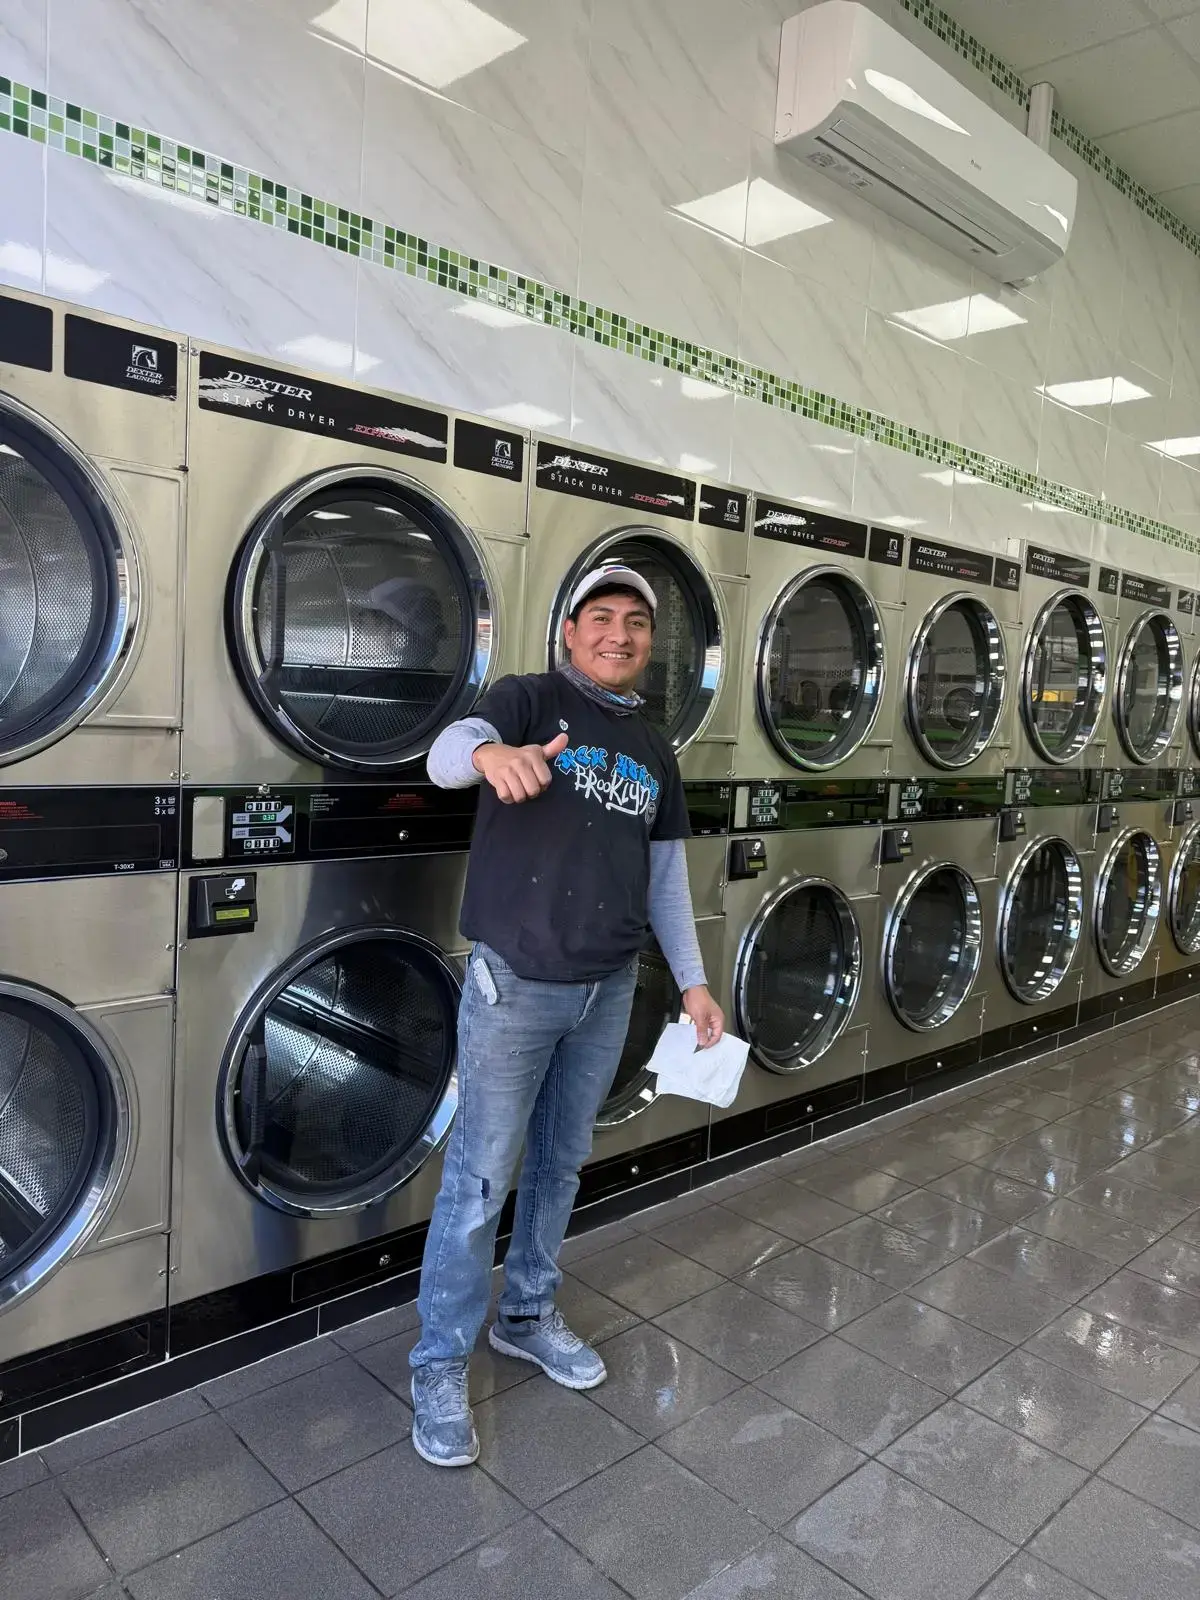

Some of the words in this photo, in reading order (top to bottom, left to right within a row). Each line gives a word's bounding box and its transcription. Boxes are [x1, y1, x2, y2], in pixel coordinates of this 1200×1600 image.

[126, 366, 163, 380] DEXTER
[126, 373, 163, 385] LAUNDRY
[224, 371, 313, 401] DEXTER
[222, 392, 275, 413] STACK
[288, 408, 336, 427] DRYER
[353, 424, 407, 444] EXPRESS
[552, 455, 609, 476] DEXTER
[550, 472, 584, 488] STACK
[592, 483, 622, 496] DRYER
[633, 493, 669, 506] EXPRESS
[766, 509, 806, 525] DEXTER
[764, 524, 788, 535] STACK
[793, 531, 815, 541] DRYER
[917, 546, 947, 558] DEXTER
[1033, 552, 1056, 564] DEXTER
[916, 558, 934, 568] STACK
[154, 796, 161, 805] 3
[154, 807, 161, 816] 3
